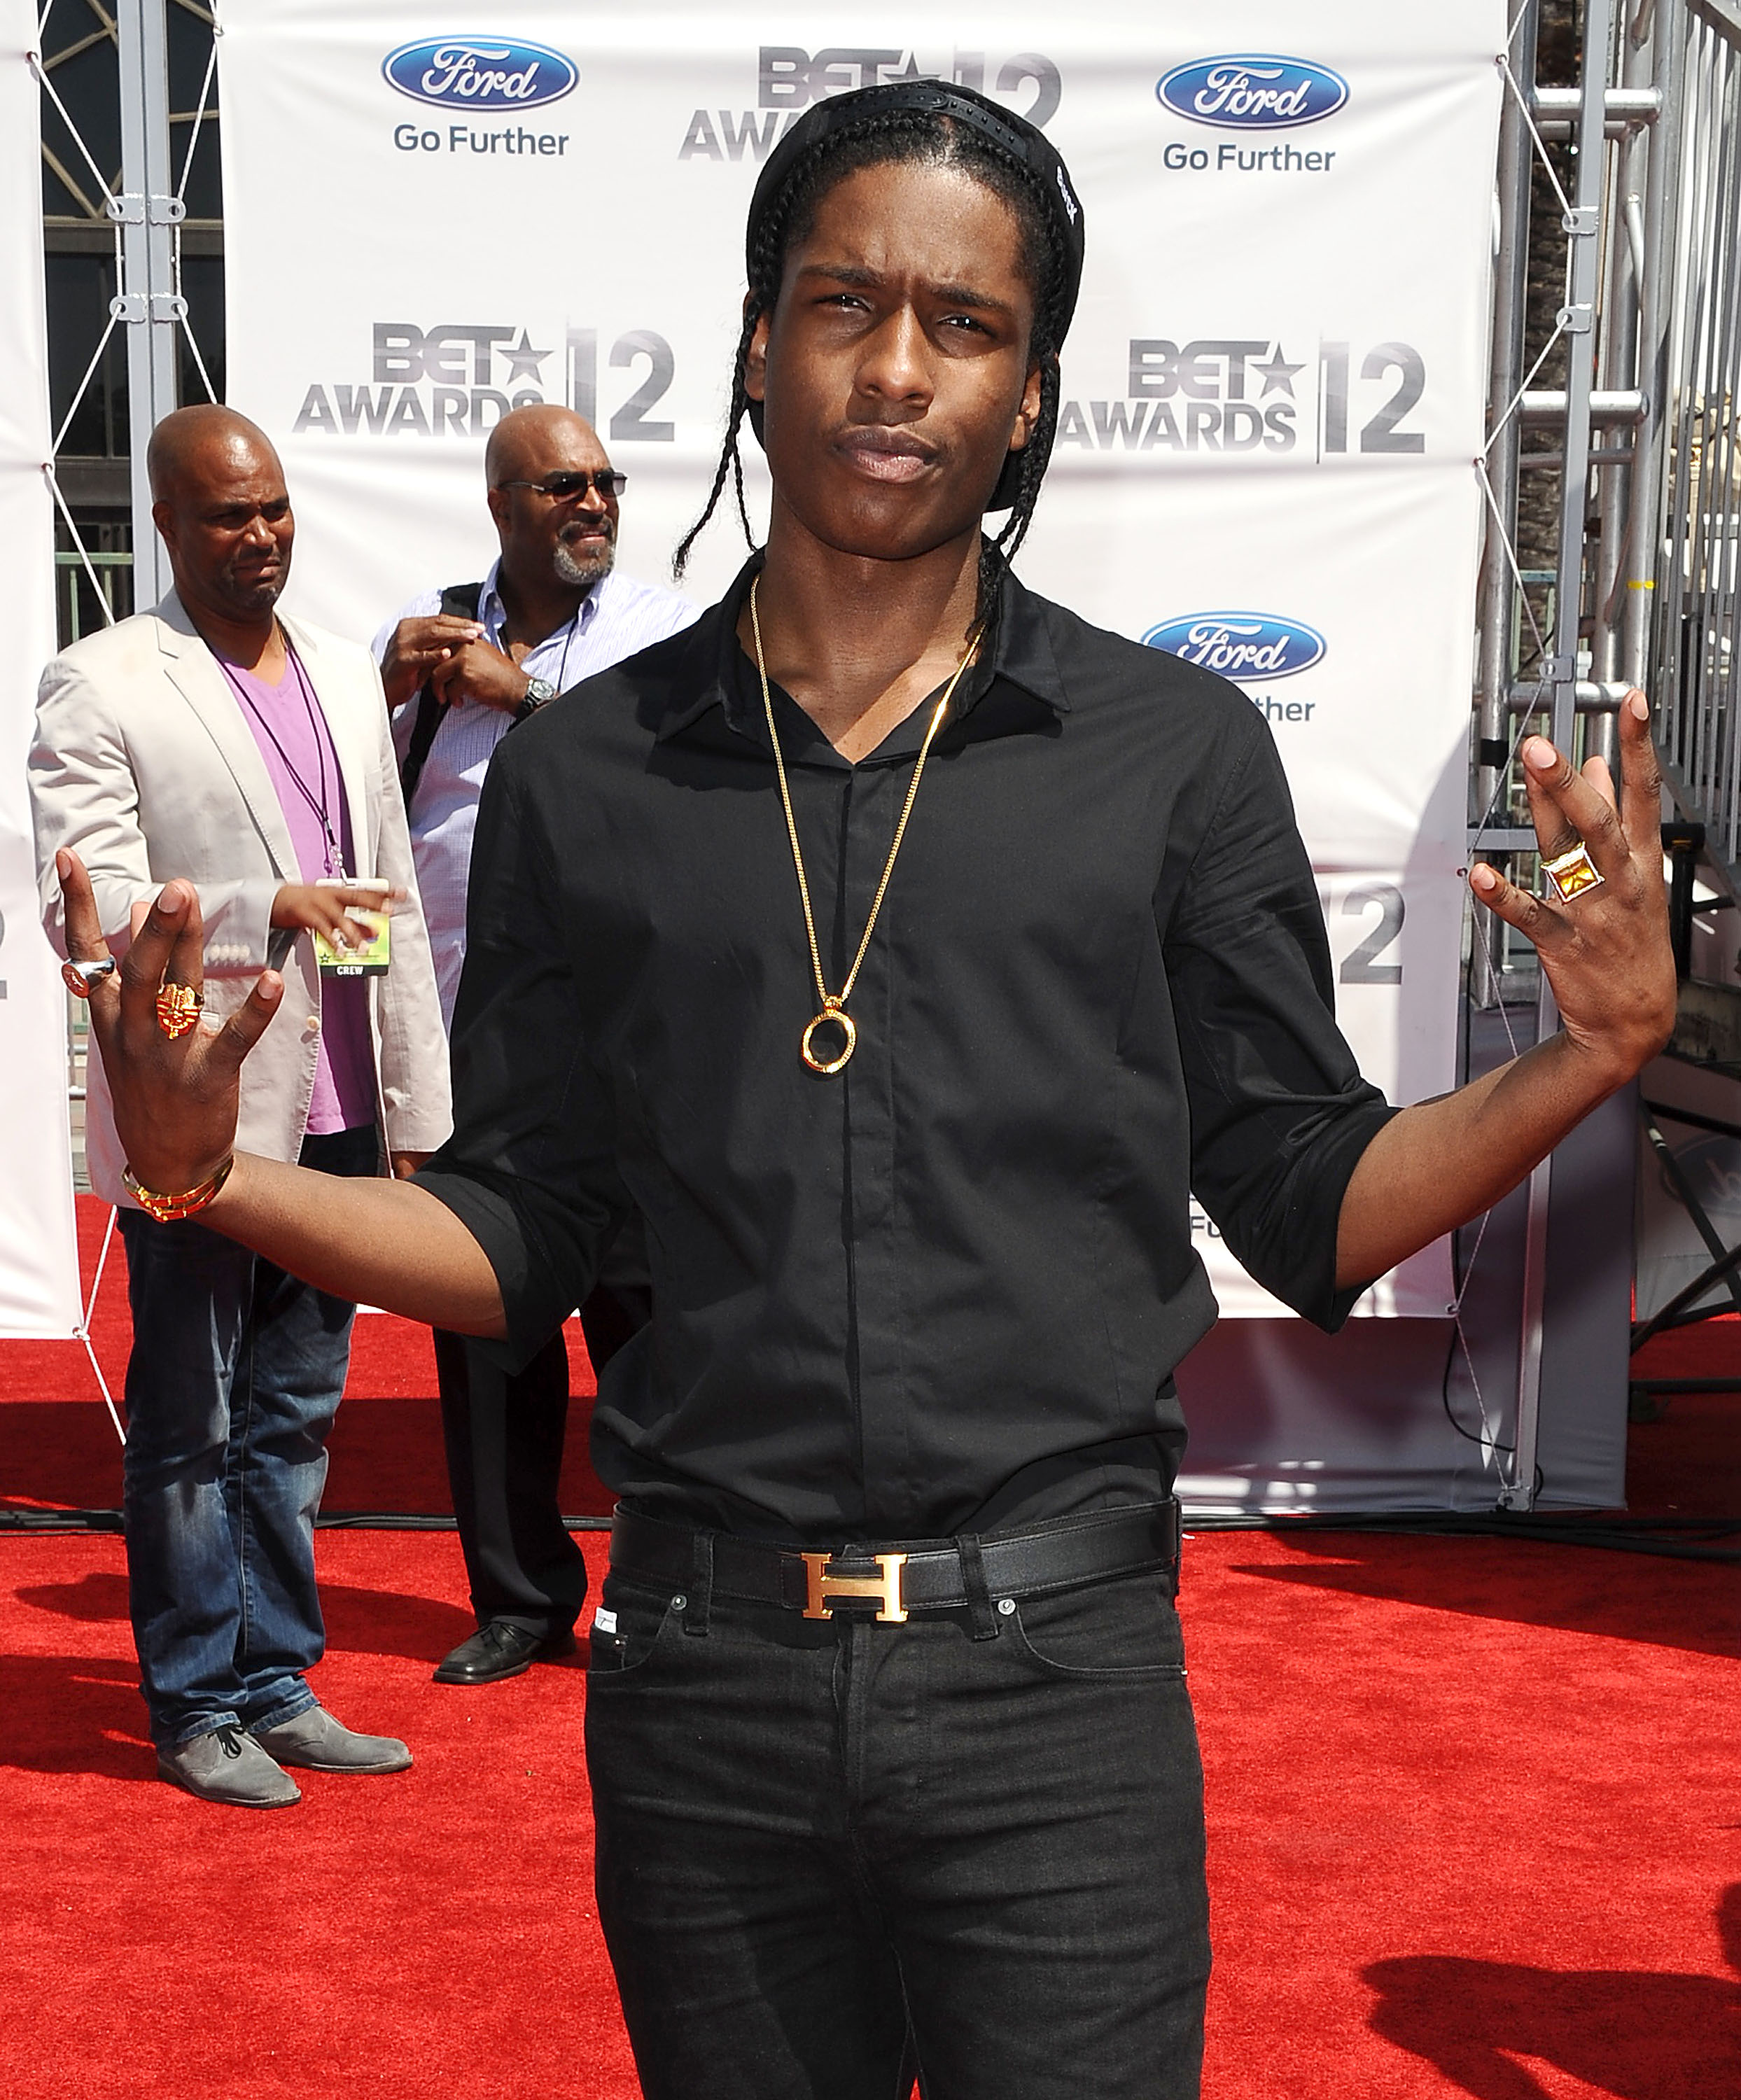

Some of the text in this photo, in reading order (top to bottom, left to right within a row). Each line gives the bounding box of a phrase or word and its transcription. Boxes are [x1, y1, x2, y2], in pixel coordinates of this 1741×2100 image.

[421, 46, 540, 99] Ford
[758, 46, 904, 108] BET
[1194, 64, 1312, 117] Ford
[393, 125, 569, 155] Go Further
[1163, 144, 1336, 172] Go Further
[373, 323, 517, 385] BET
[1128, 340, 1271, 400] BET
[566, 328, 675, 441] 12
[1321, 341, 1426, 454] 12
[1055, 401, 1296, 451] AWARDS
[1176, 621, 1290, 670] Ford
[337, 966, 364, 975] CREW
